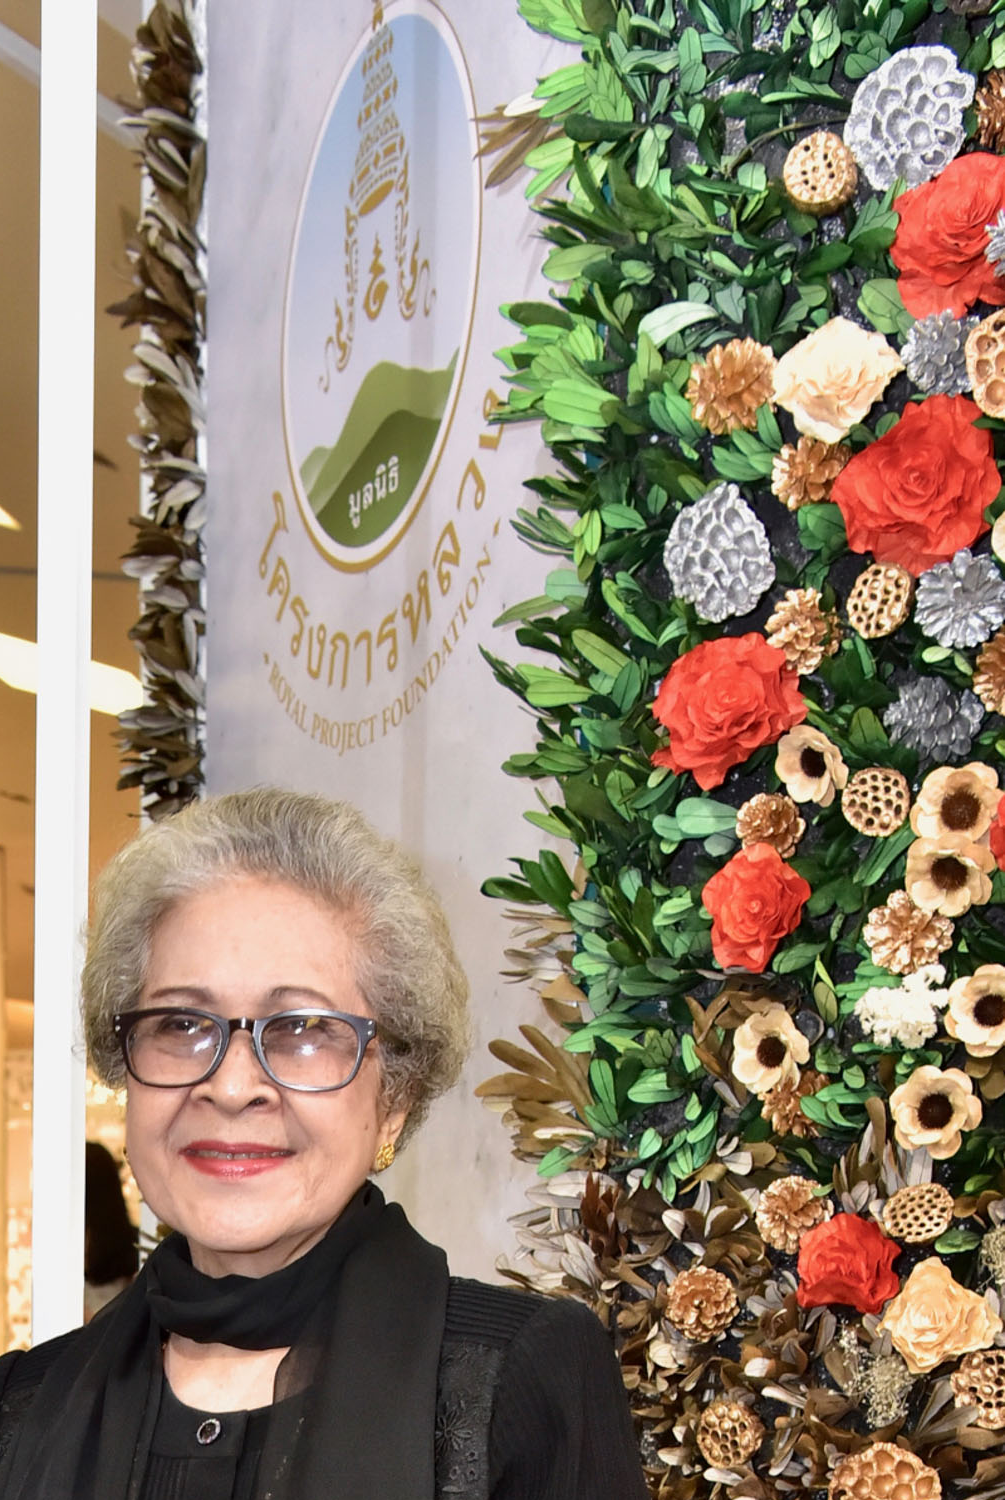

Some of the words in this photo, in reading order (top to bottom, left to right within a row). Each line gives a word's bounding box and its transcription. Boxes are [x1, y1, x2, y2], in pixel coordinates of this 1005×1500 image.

[349, 455, 399, 529] มูลนิธิ
[268, 661, 307, 733] ROYAL
[311, 712, 377, 757] PROJECT
[381, 541, 491, 736] FOUNDATION
